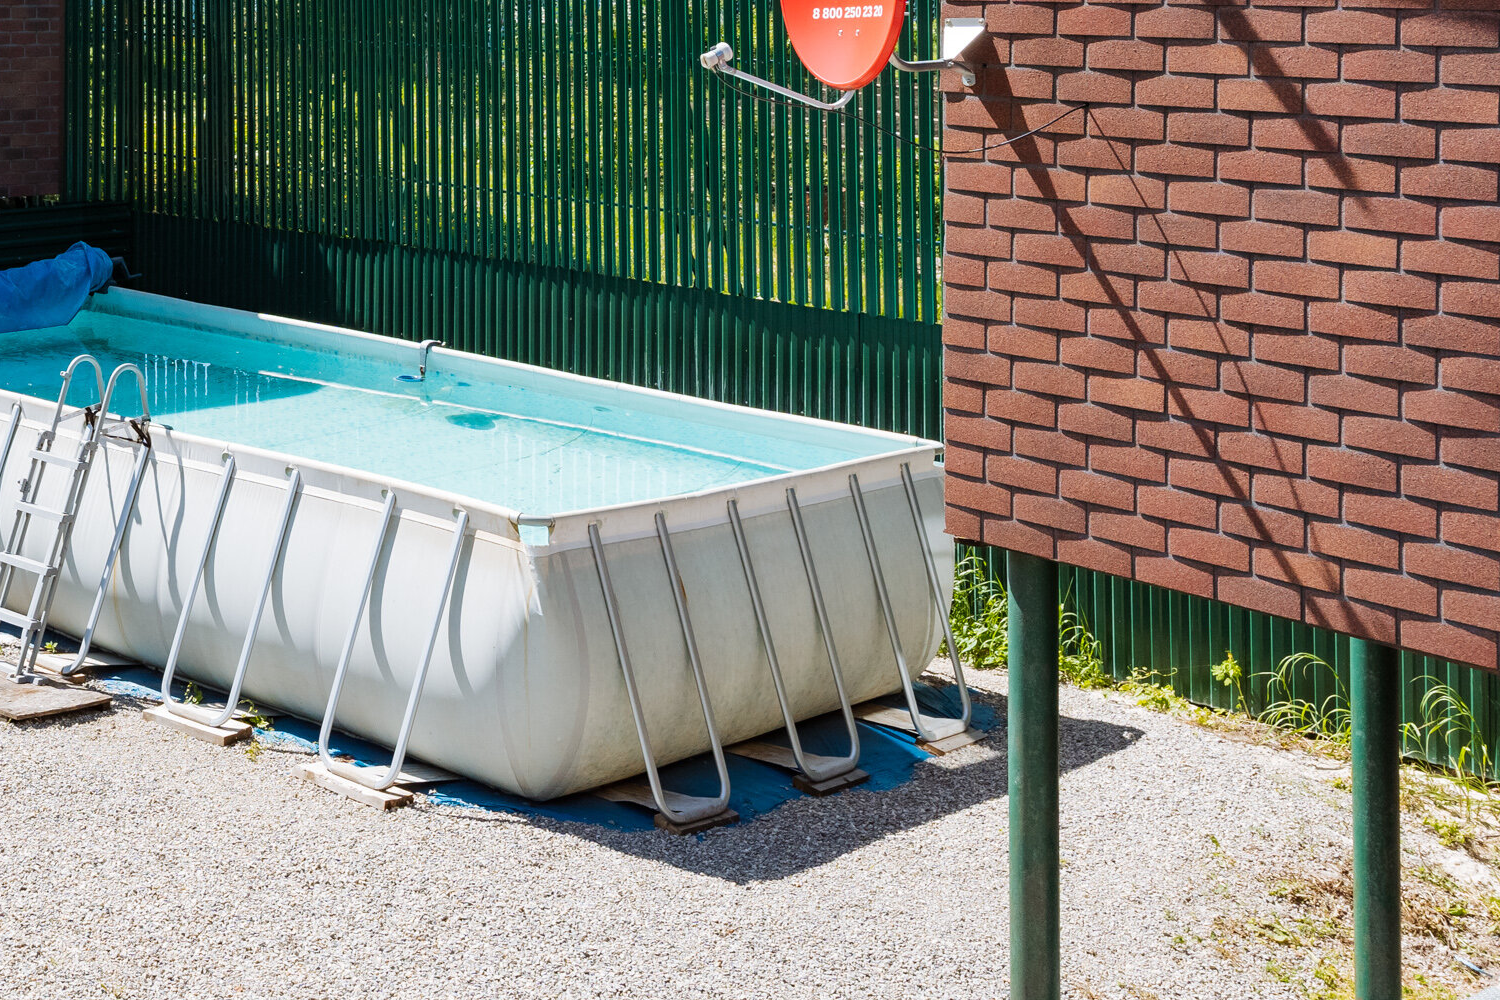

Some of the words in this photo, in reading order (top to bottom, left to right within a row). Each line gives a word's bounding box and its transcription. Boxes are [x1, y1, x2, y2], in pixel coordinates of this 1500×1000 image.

[813, 8, 820, 19] 8
[822, 7, 843, 19] 800
[844, 6, 861, 18] 250
[862, 5, 873, 18] 23
